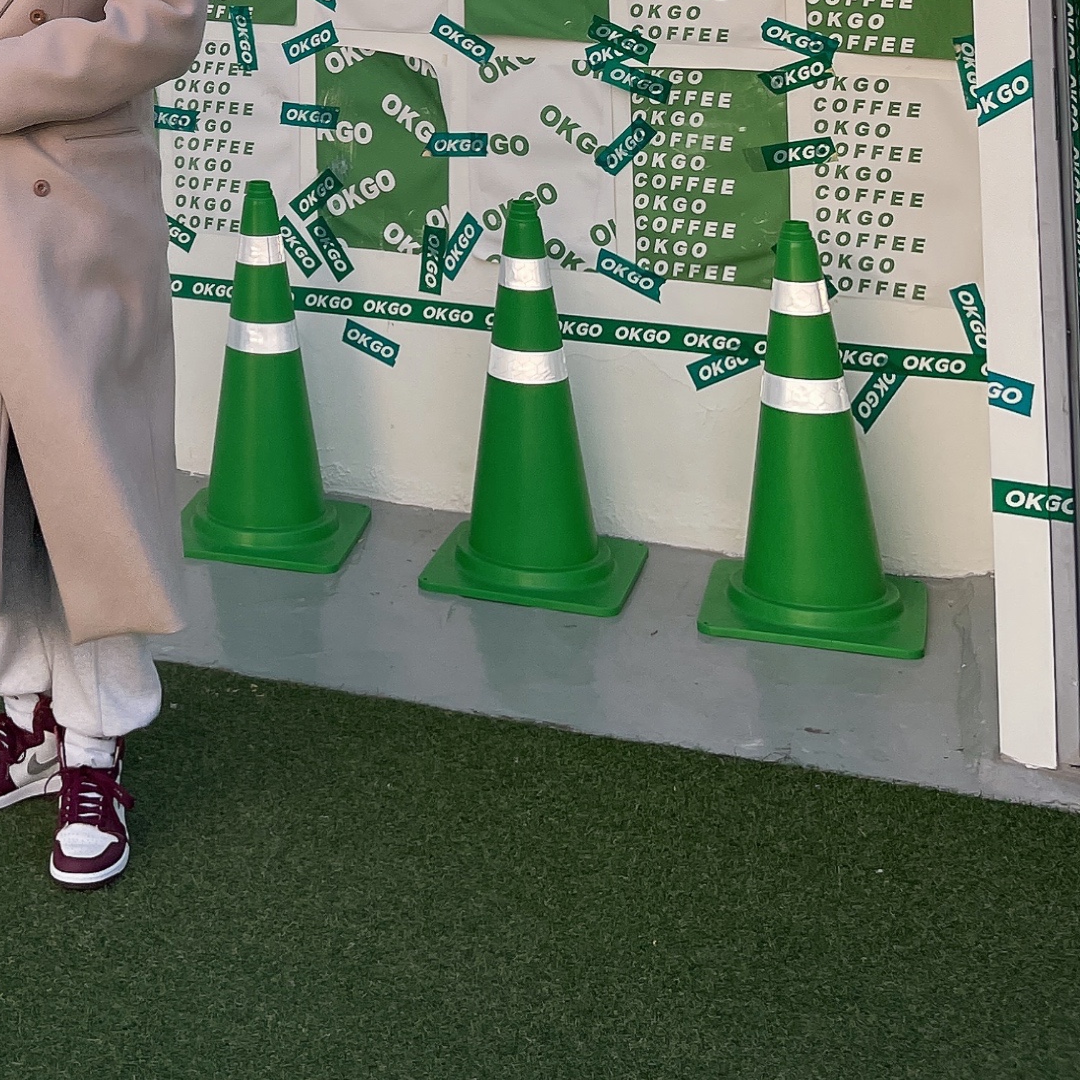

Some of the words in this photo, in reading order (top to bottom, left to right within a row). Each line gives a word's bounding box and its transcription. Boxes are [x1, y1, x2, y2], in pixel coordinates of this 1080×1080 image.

[630, 3, 701, 20] OKGO
[807, 11, 885, 30] OKGO
[289, 29, 331, 58] OKGO
[438, 23, 487, 58] OKGO
[766, 25, 825, 53] OKGO
[174, 79, 231, 95] OKGO
[286, 108, 333, 124] OKGO
[814, 97, 922, 119] COFFEE
[814, 119, 891, 138] OKGO
[174, 137, 255, 155] COFFEE
[434, 139, 484, 152] OKGO
[607, 128, 646, 169] OKGO
[773, 144, 830, 163] OKGO
[174, 158, 232, 172] OKGO
[634, 151, 705, 171] OKGO
[634, 173, 735, 195] COFFEE
[815, 163, 892, 183] OKGO
[175, 194, 232, 212] OKGO
[326, 170, 396, 217] OKGO
[634, 193, 707, 214] OKGO
[815, 185, 925, 209] COFFEE
[635, 215, 736, 239] COFFEE
[816, 207, 894, 228] OKGO
[314, 225, 347, 273] OKGO
[444, 224, 475, 271] OKGO
[636, 236, 707, 259] OKGO
[818, 229, 926, 254] COFFEE
[600, 258, 654, 291] OKGO
[304, 293, 353, 310] OKGO
[363, 299, 412, 317] OKGO
[423, 306, 473, 323] OKGO
[614, 326, 671, 343] OKGO
[683, 332, 741, 351] OKGO
[903, 355, 966, 374] OKGO
[346, 329, 395, 359] OKGO
